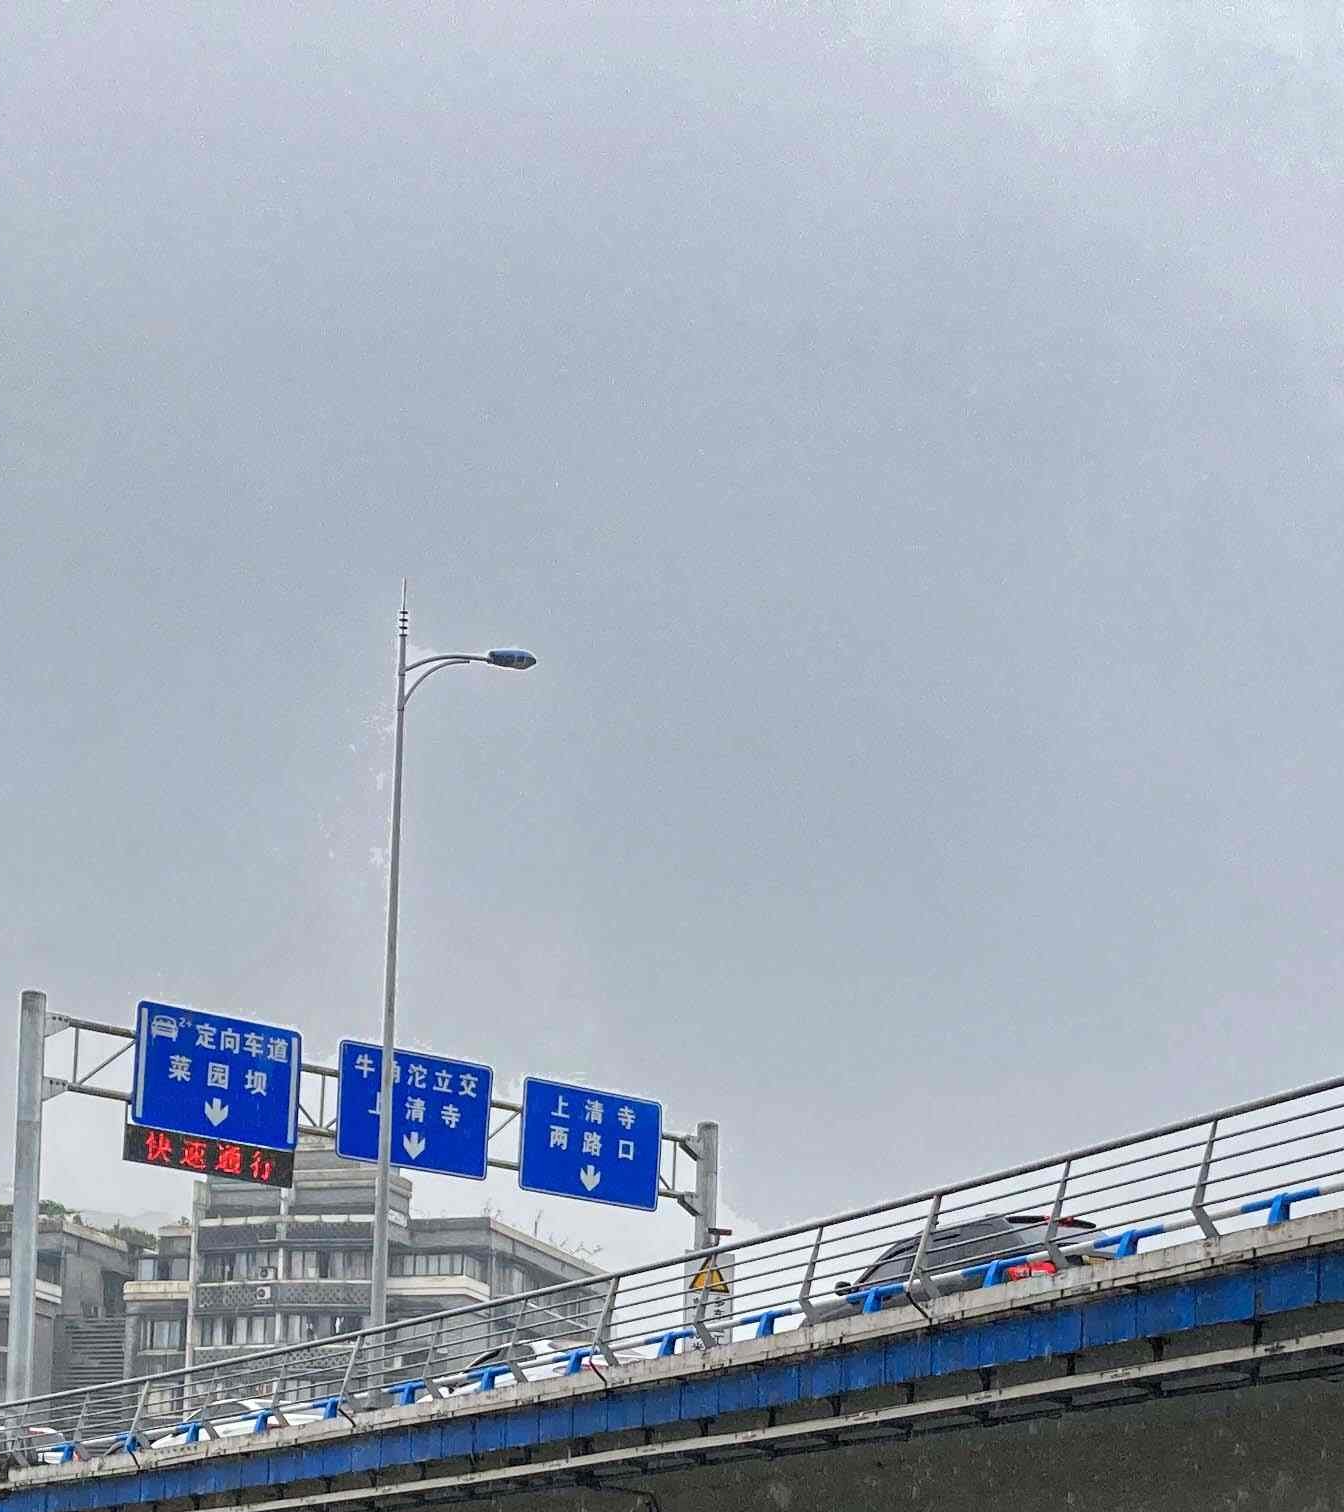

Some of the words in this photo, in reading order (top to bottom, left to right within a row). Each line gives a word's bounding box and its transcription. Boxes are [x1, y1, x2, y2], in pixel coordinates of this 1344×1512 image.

[195, 1023, 289, 1063] 定向车道
[168, 1055, 267, 1097] 菜园坝
[368, 1091, 461, 1128] 上清寺
[551, 1095, 636, 1130] 上清寺
[145, 1131, 273, 1180] 快速通行
[549, 1125, 635, 1161] 两路口
